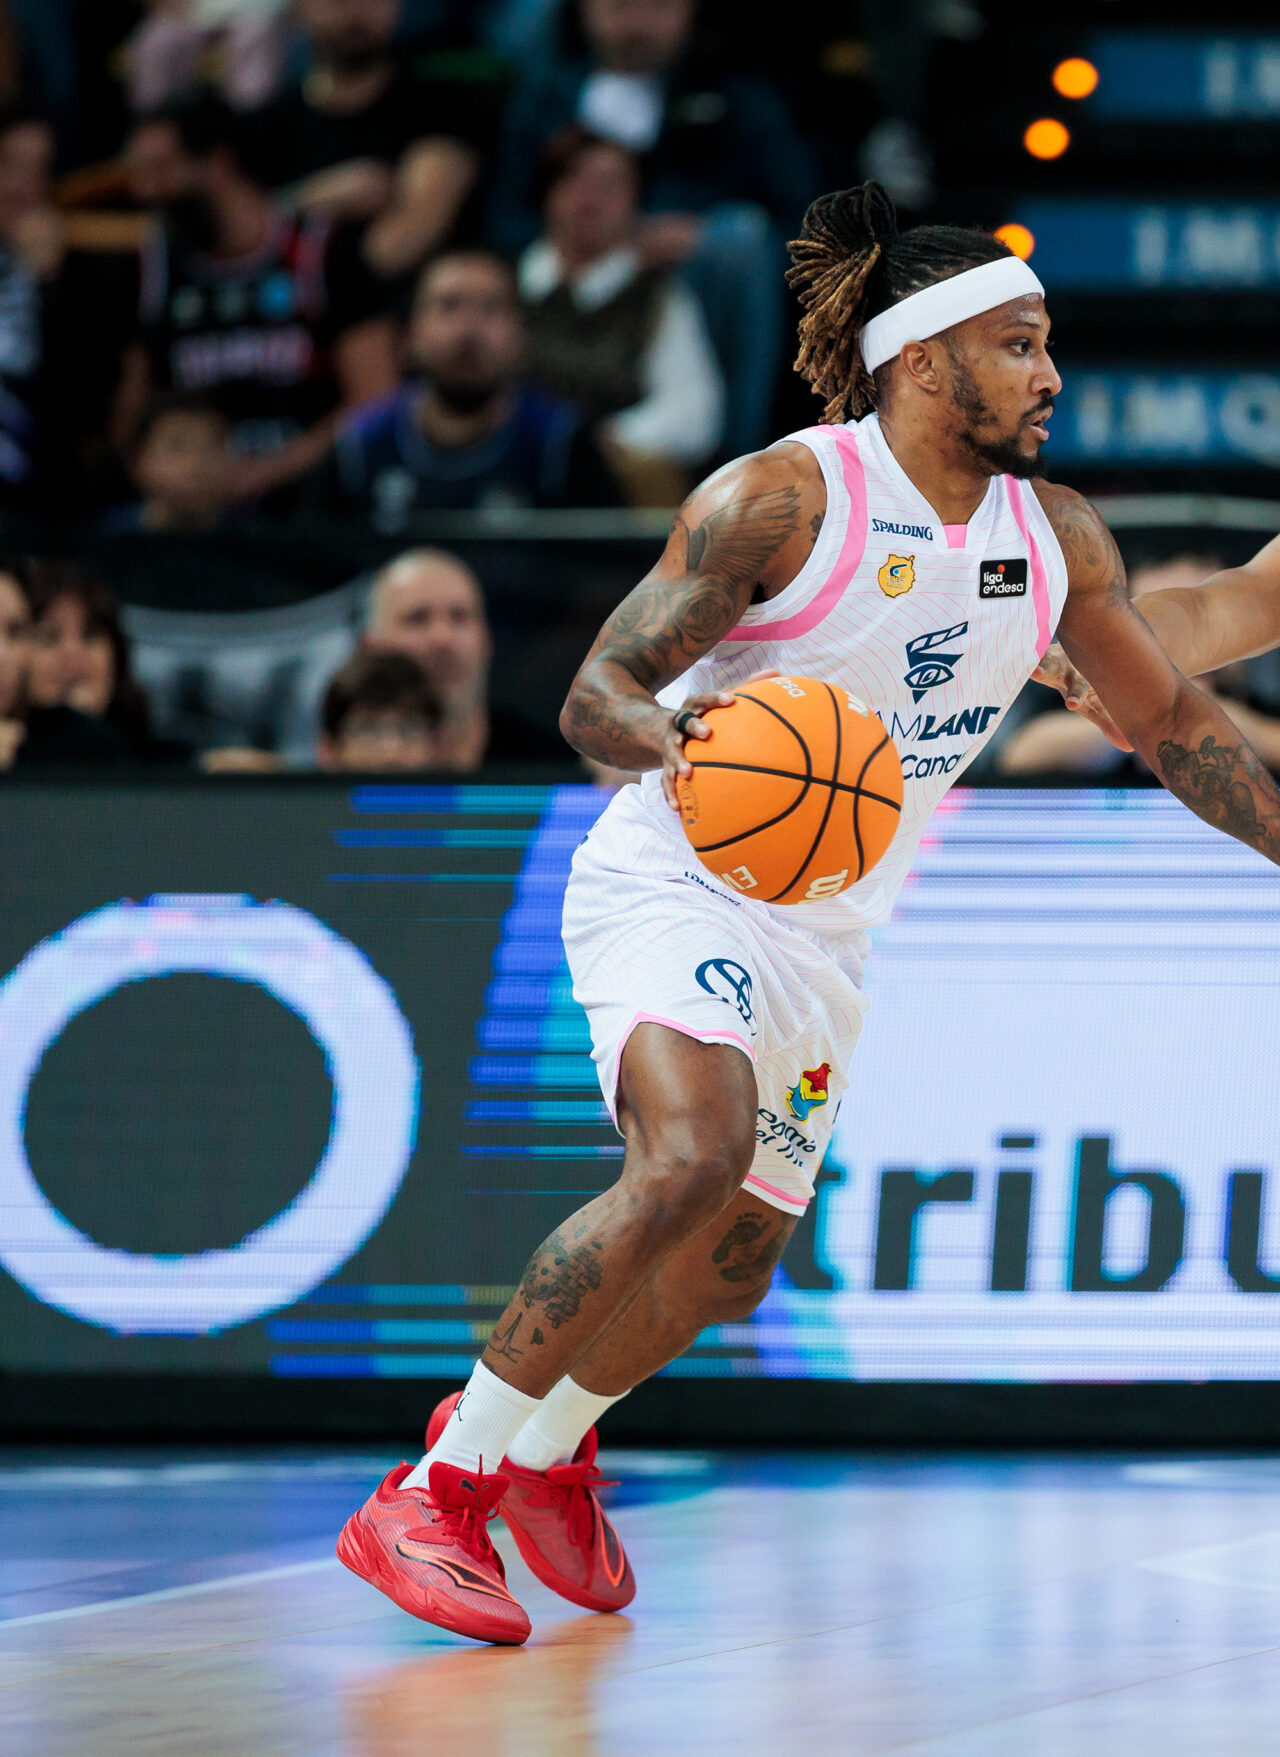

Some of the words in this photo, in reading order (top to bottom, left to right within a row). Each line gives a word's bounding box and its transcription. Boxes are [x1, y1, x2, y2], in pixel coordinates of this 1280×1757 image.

[872, 518, 934, 542] SPALDING
[983, 571, 1003, 585] liga
[983, 582, 1024, 595] endesa
